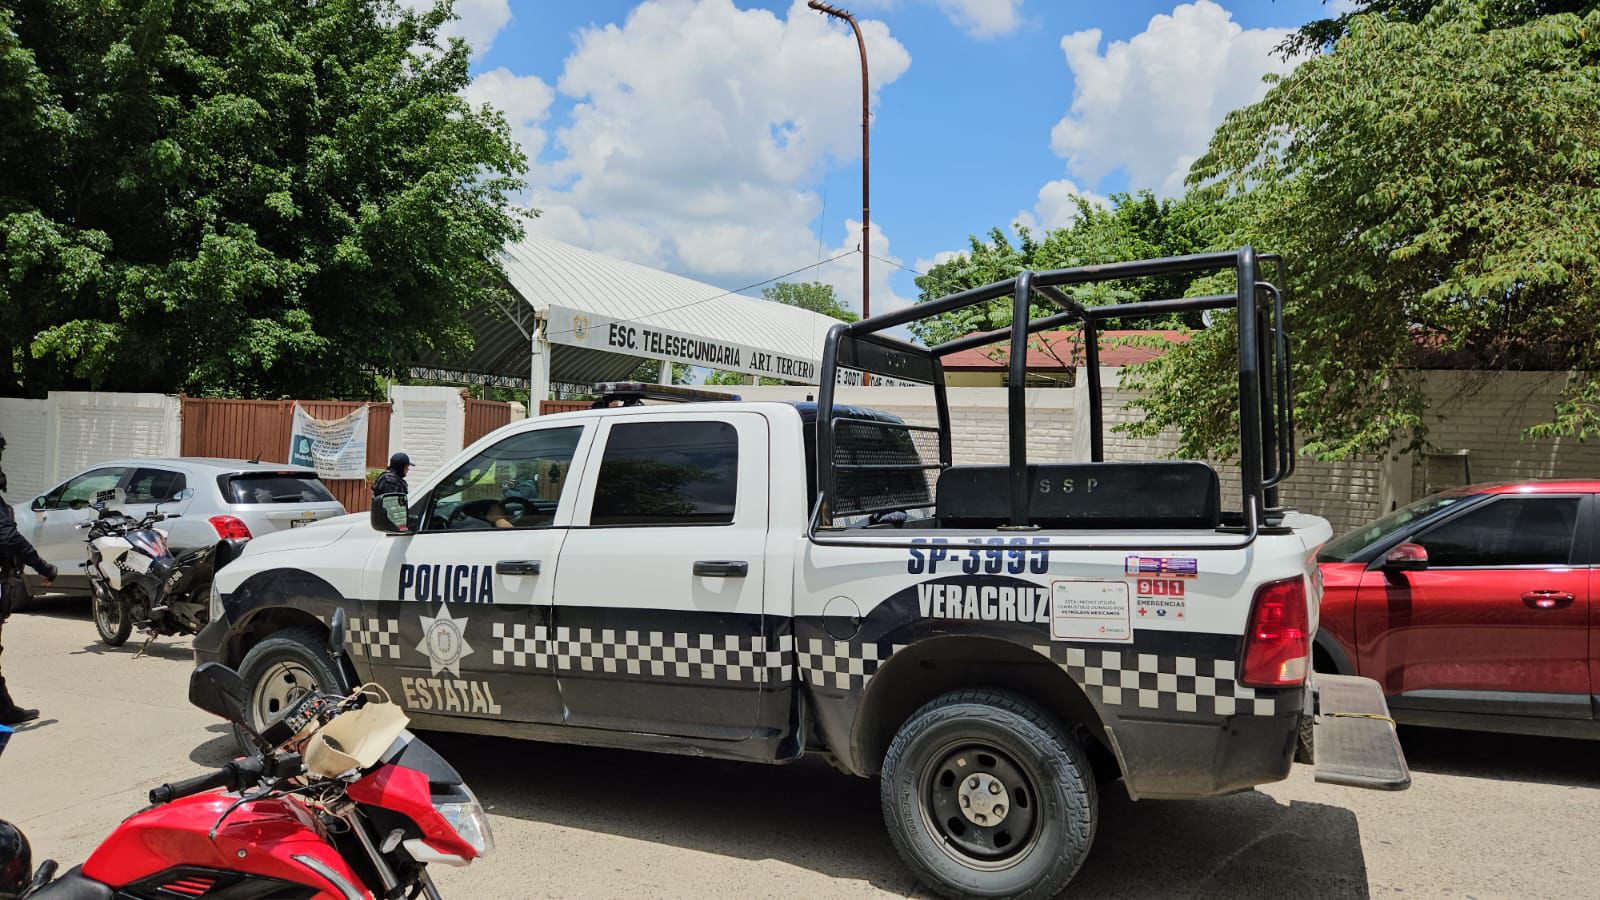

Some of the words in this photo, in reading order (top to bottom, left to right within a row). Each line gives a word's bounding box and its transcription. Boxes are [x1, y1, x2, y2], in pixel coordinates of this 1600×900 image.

[609, 323, 638, 350] ESC.
[643, 330, 741, 367] TELESECUNDARIA
[749, 352, 773, 373] ART.
[776, 356, 814, 379] TERCERO
[907, 537, 1050, 575] SP-3995
[398, 564, 494, 604] POLICIA
[917, 583, 1050, 624] VERACRUZ
[401, 676, 502, 715] ESTATAL
